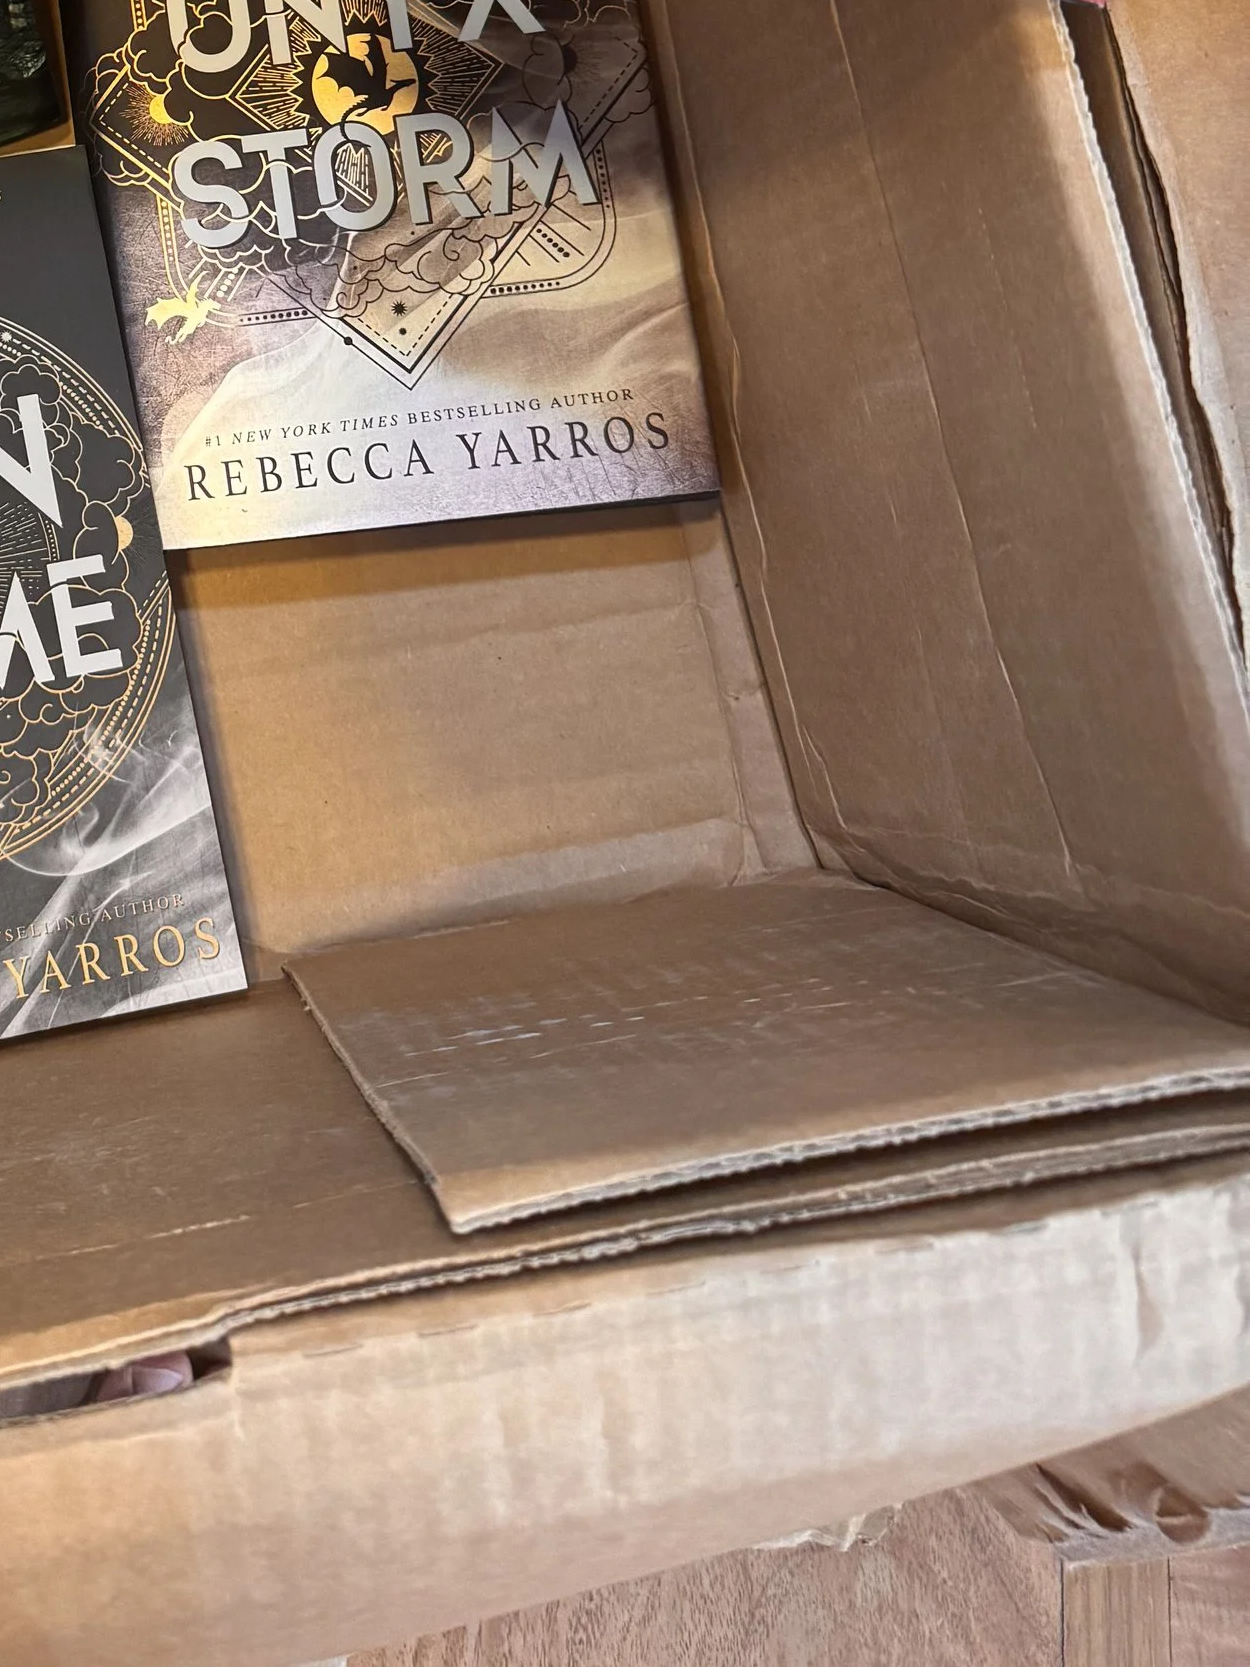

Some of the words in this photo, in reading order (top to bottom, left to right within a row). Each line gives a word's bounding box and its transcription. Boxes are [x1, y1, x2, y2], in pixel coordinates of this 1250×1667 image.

[172, 98, 603, 250] STORM
[184, 438, 435, 501] REBECCA
[456, 412, 669, 470] YARROS
[205, 434, 222, 447] #1
[232, 429, 272, 445] NEW
[280, 422, 332, 439] YORK
[340, 414, 399, 432] TIMES
[407, 398, 541, 424] BESTSELLING
[550, 388, 634, 409] AUTHOR
[101, 893, 185, 922] AUTHOR
[2, 917, 221, 999] YARROS
